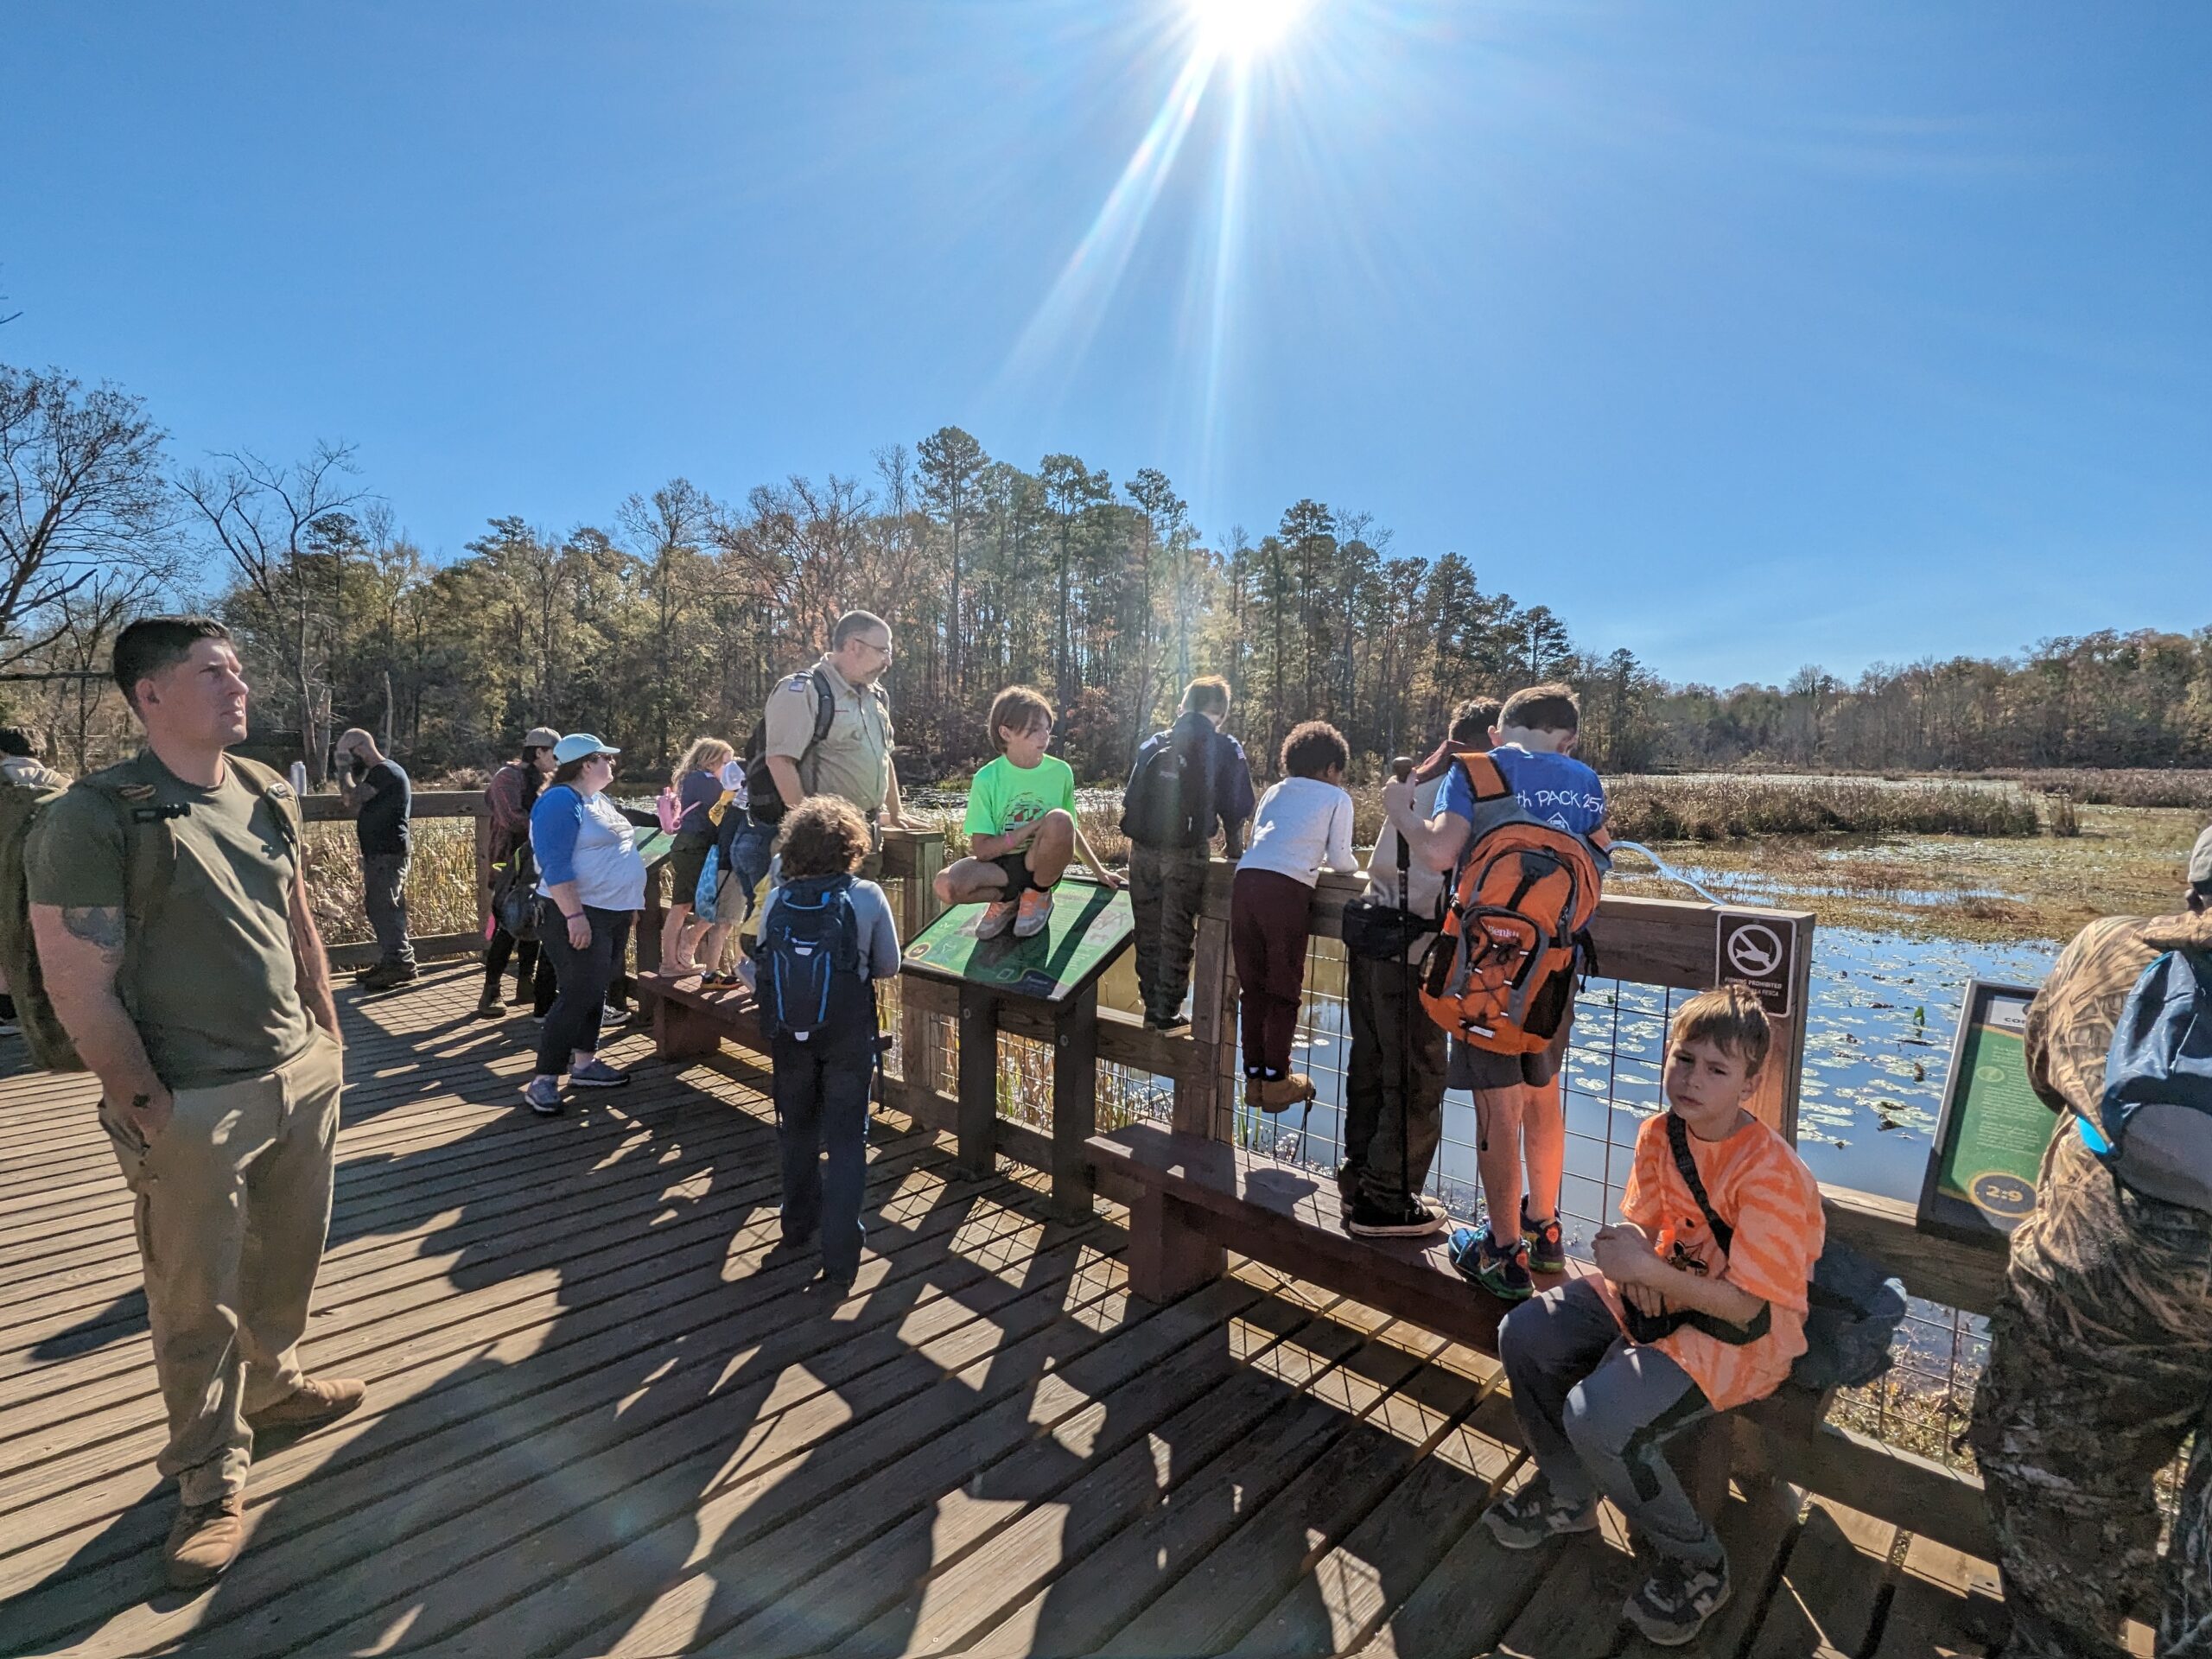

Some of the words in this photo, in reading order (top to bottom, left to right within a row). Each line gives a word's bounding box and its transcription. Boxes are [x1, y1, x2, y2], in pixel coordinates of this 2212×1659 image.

[1535, 790, 1581, 809] PACK
[1749, 979, 1782, 989] PROHIBITED
[1986, 1184, 2024, 1203] 2:9
